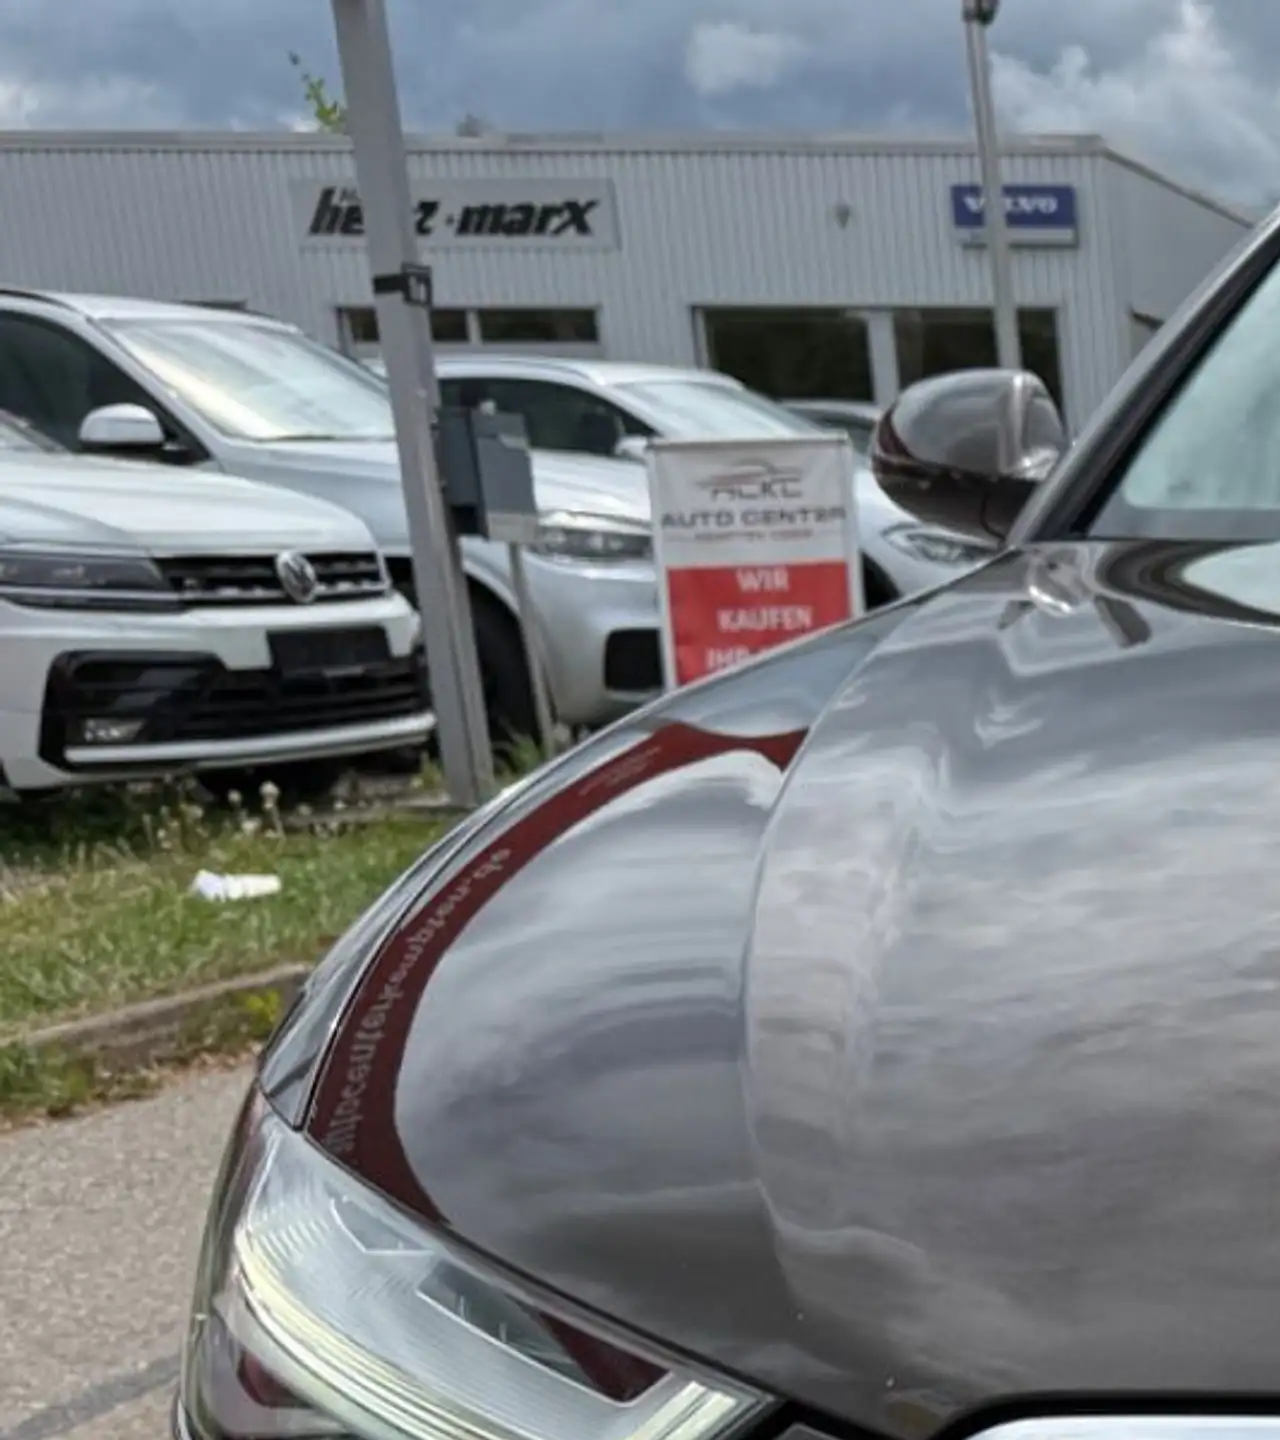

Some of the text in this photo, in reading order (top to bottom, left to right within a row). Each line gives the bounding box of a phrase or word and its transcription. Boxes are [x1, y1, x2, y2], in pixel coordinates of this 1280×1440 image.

[456, 200, 597, 236] marx
[661, 505, 847, 528] AUTO CENTER
[736, 567, 790, 592] WIR
[716, 606, 814, 633] KAUFEN
